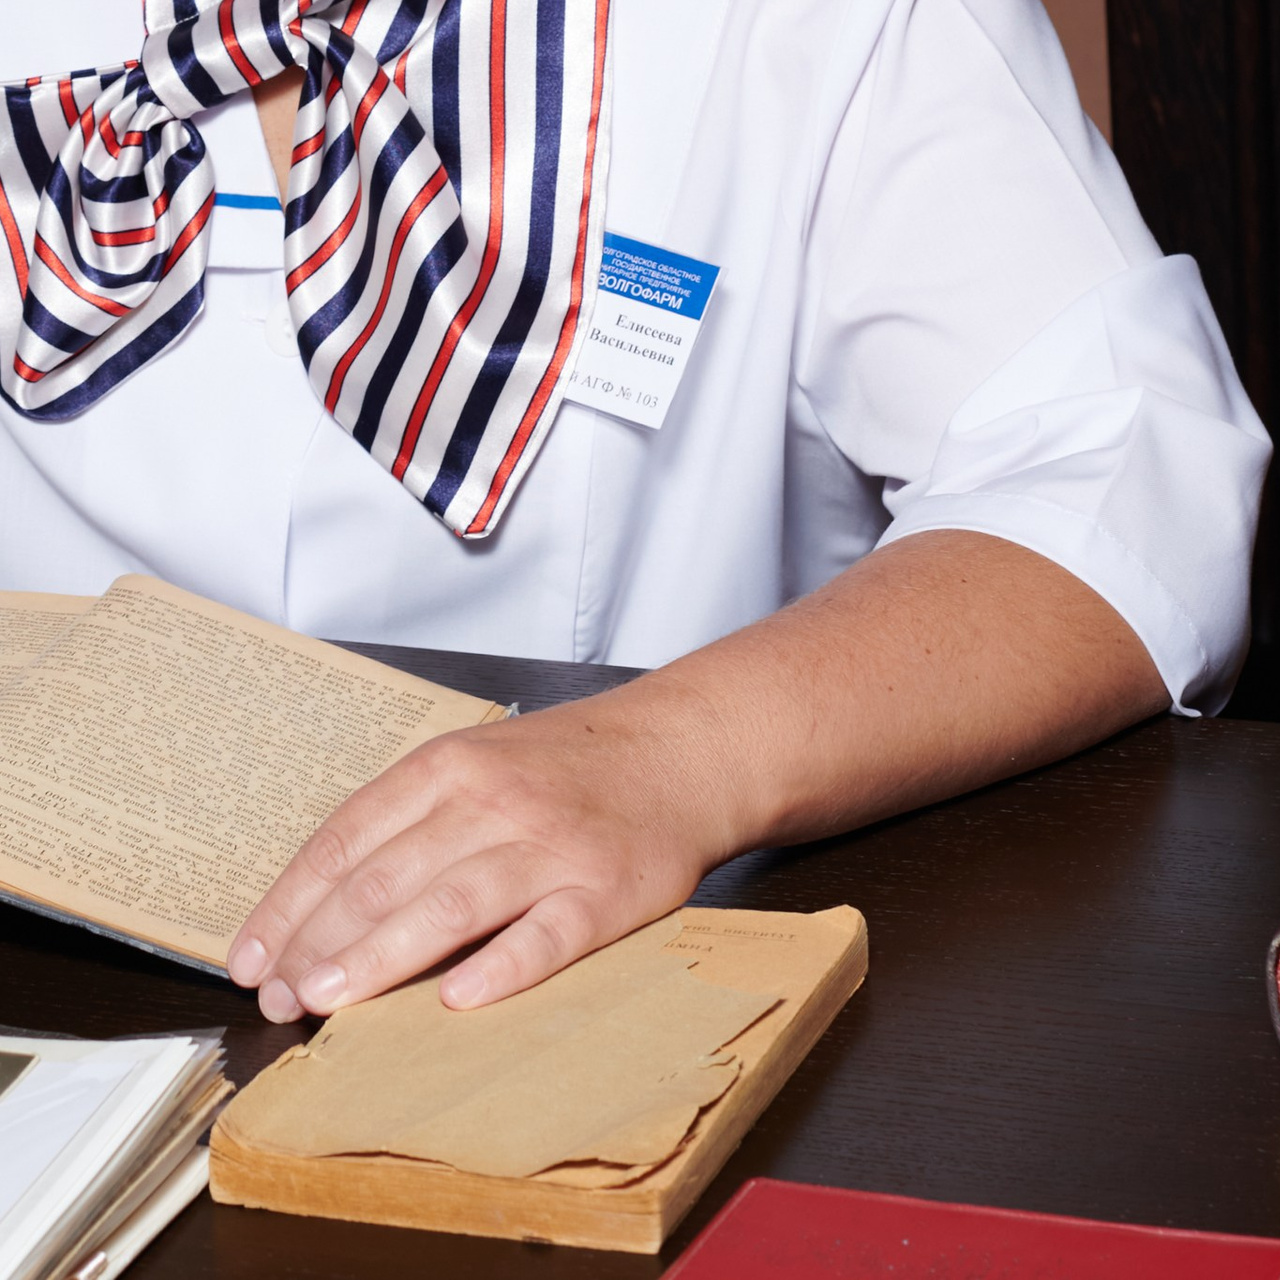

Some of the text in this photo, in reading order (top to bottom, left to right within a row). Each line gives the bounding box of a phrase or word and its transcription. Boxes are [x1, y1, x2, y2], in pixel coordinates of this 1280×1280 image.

[602, 246, 701, 283] ОЛГОГРАДСКОЕ ОБЛАСТНОЕ
[611, 258, 681, 286] ГОСУДАРСТВЕННОЕ
[639, 275, 692, 298] ПРЕДПРИЯТИЕ
[589, 327, 675, 367] Васильевна
[615, 313, 682, 347] Елисеева
[581, 375, 615, 394] АГФ
[635, 391, 658, 409] 103
